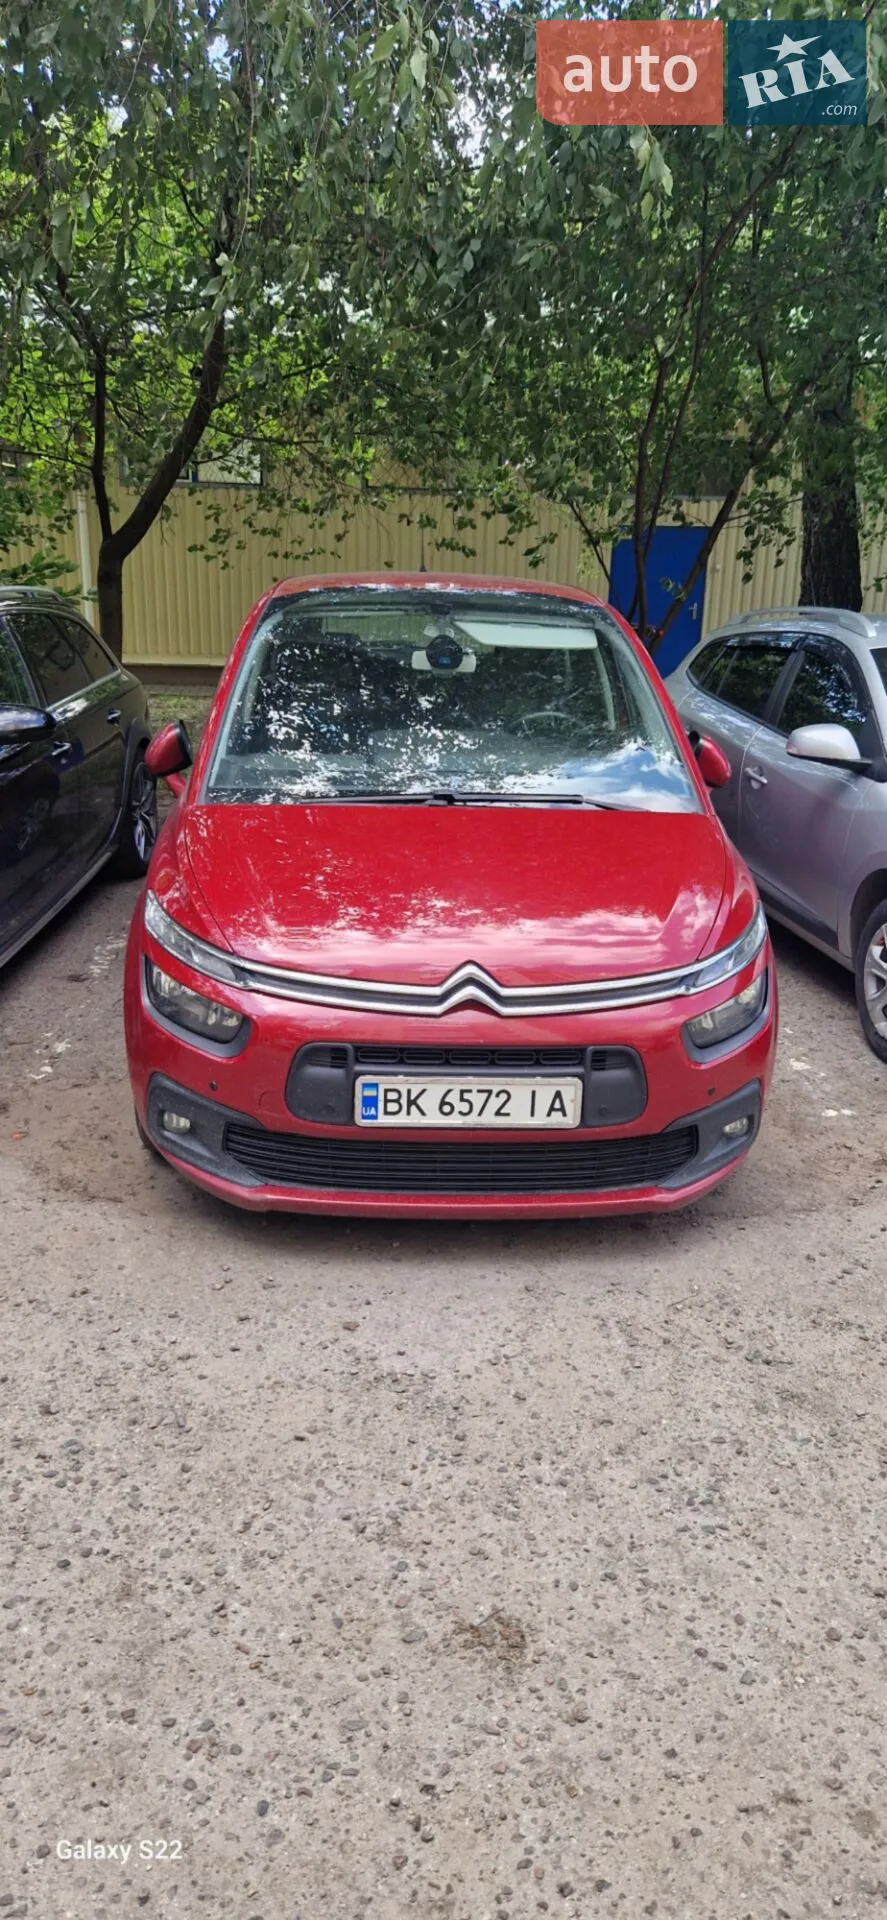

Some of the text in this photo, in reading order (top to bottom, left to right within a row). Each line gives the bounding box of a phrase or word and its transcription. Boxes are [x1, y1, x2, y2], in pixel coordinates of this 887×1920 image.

[383, 1088, 427, 1117] BK
[438, 1089, 511, 1117] 6572
[362, 1108, 377, 1117] UA
